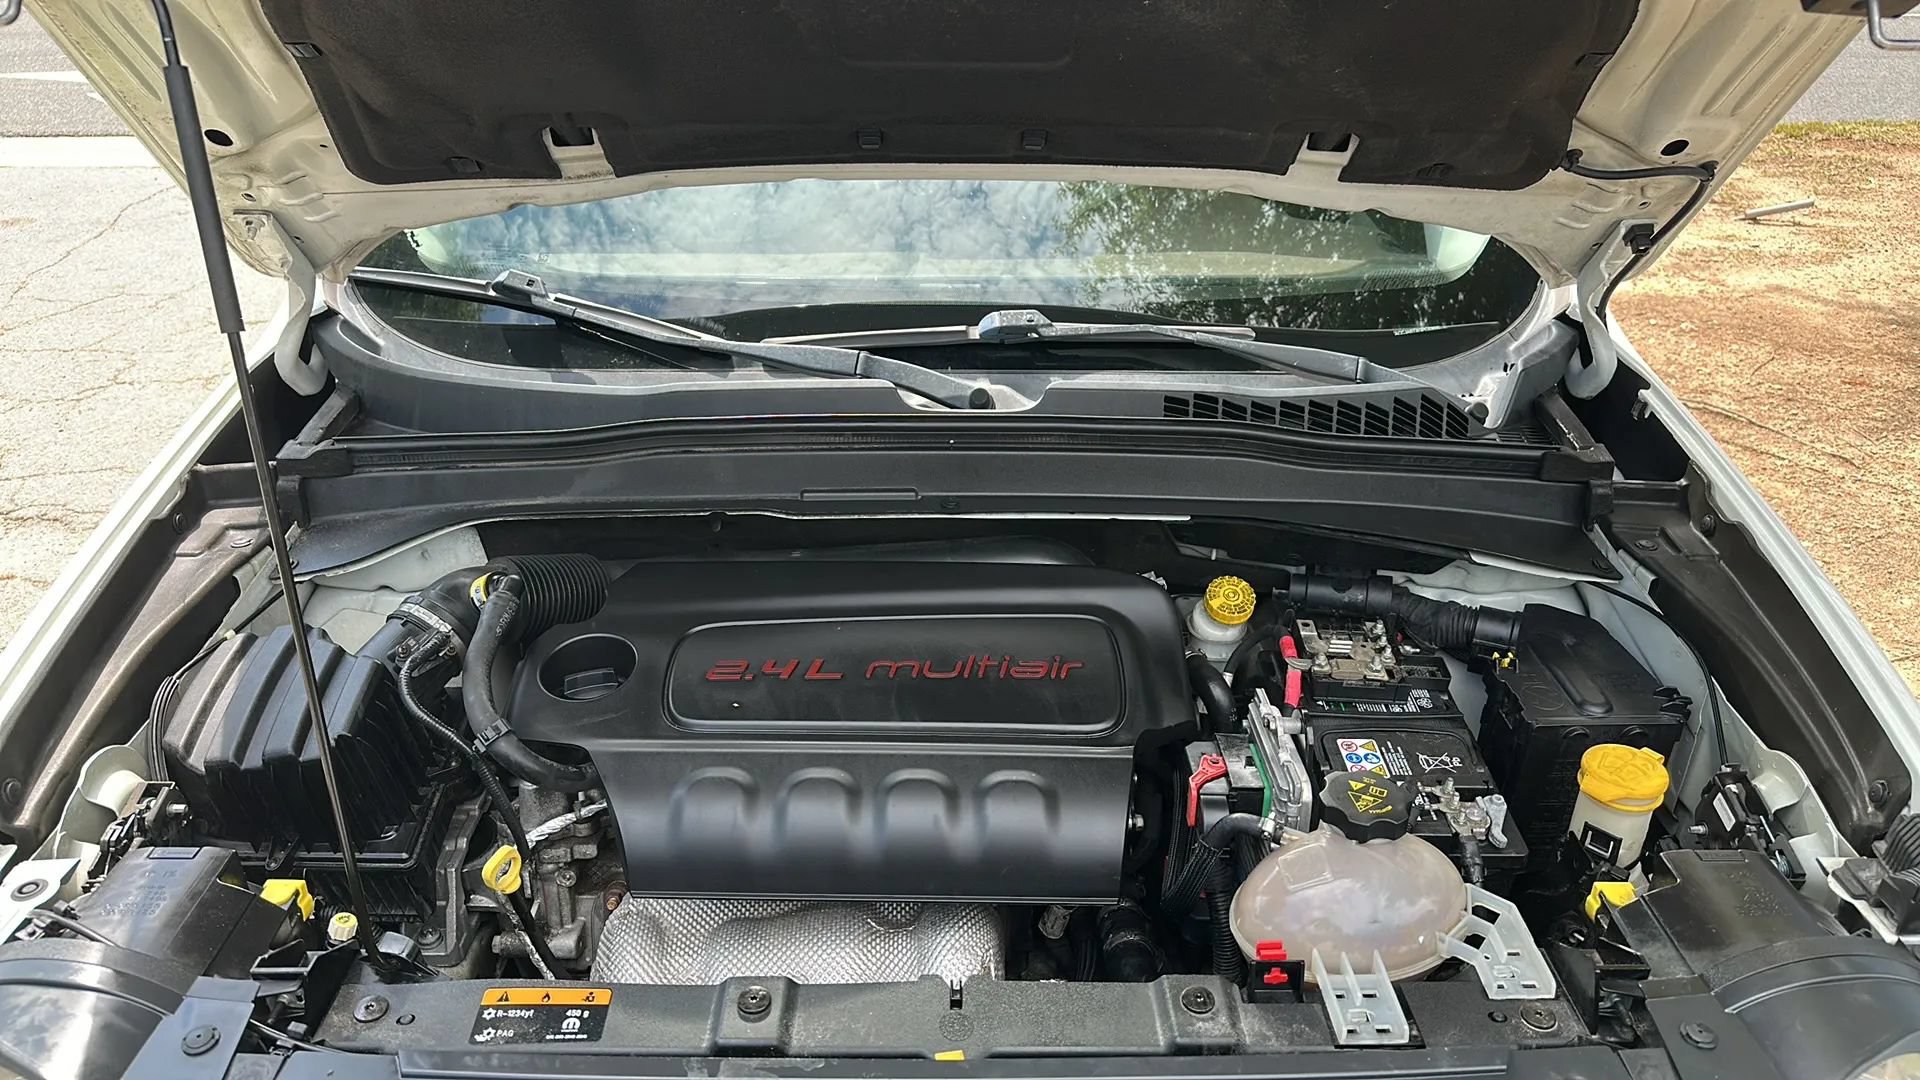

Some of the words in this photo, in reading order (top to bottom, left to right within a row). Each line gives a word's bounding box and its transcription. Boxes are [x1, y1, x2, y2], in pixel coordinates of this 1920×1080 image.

[865, 654, 1084, 680] multiair
[497, 1009, 534, 1019] R-1234yf
[565, 1009, 582, 1017] 450
[496, 1029, 514, 1038] PAG
